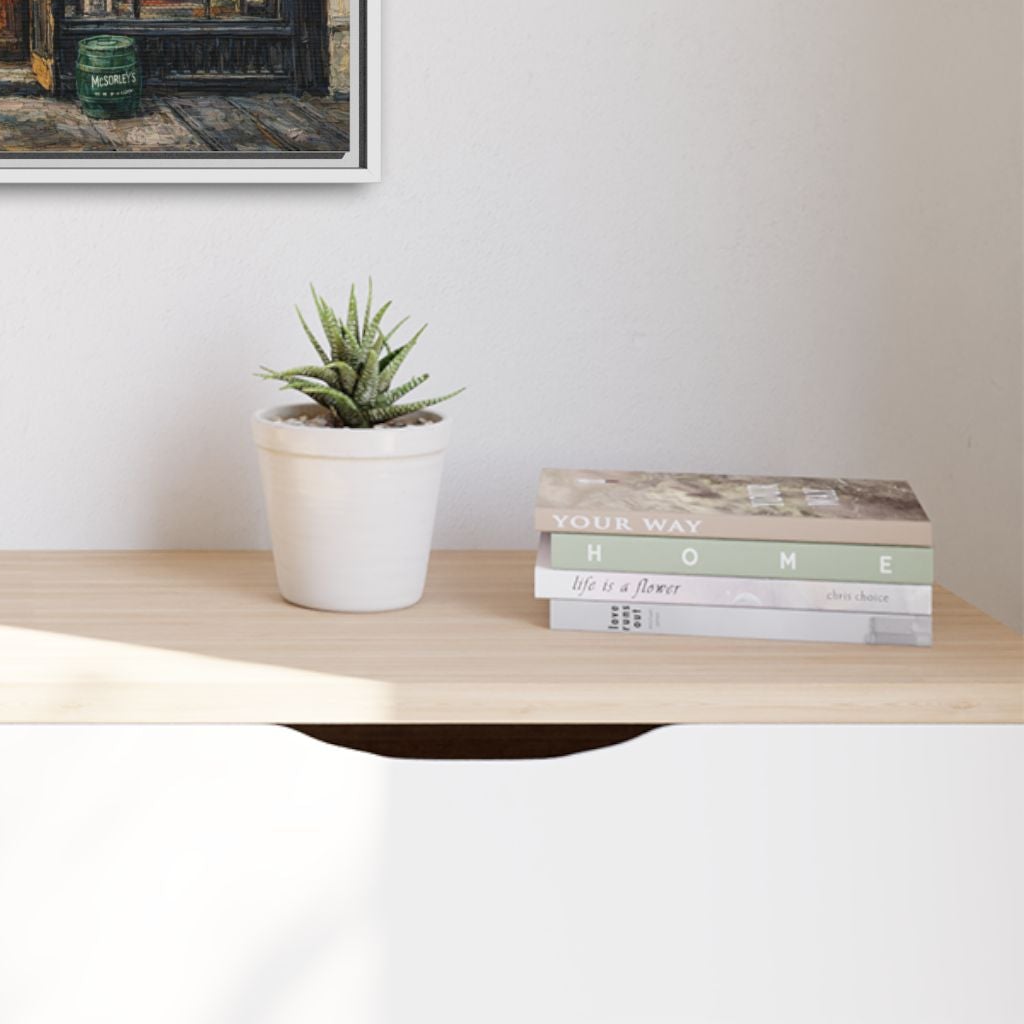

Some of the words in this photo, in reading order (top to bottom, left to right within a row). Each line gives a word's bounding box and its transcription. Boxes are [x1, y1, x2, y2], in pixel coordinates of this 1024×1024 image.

[552, 514, 632, 530] YOUR
[643, 517, 703, 533] WAY
[571, 575, 597, 597] life
[602, 578, 614, 593] is
[619, 582, 631, 593] a
[630, 578, 682, 599] flower
[826, 589, 852, 601] chris
[854, 590, 890, 604] choice
[608, 605, 619, 630] love
[621, 605, 631, 631] runs
[632, 608, 642, 629] out
